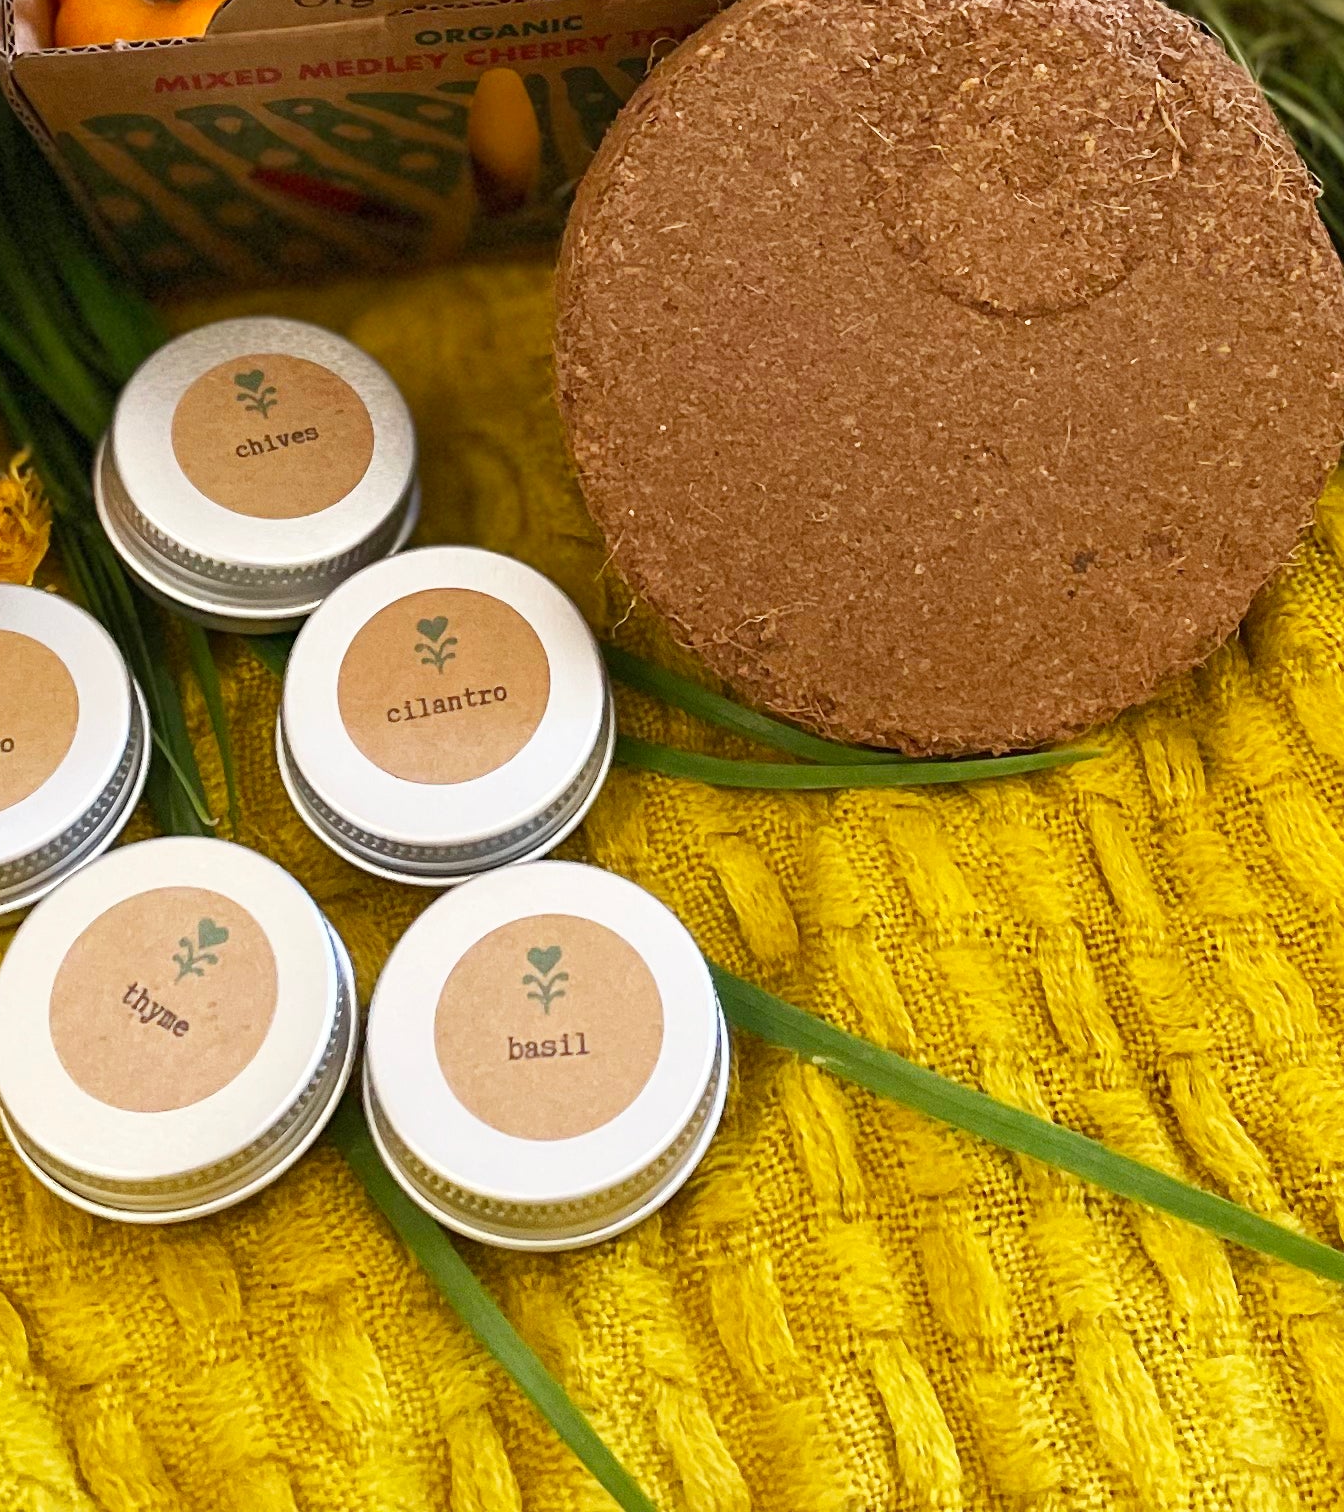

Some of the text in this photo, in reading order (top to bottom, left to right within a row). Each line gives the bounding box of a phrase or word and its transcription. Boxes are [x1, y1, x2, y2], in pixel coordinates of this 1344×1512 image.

[413, 14, 584, 47] ORGANIC
[154, 65, 284, 94] MIXED
[298, 51, 449, 82] MEDLEY
[463, 33, 613, 68] CHERRY
[233, 422, 320, 460] chives
[385, 682, 509, 726] cilantro
[121, 981, 190, 1039] thyme
[506, 1031, 591, 1063] basil
